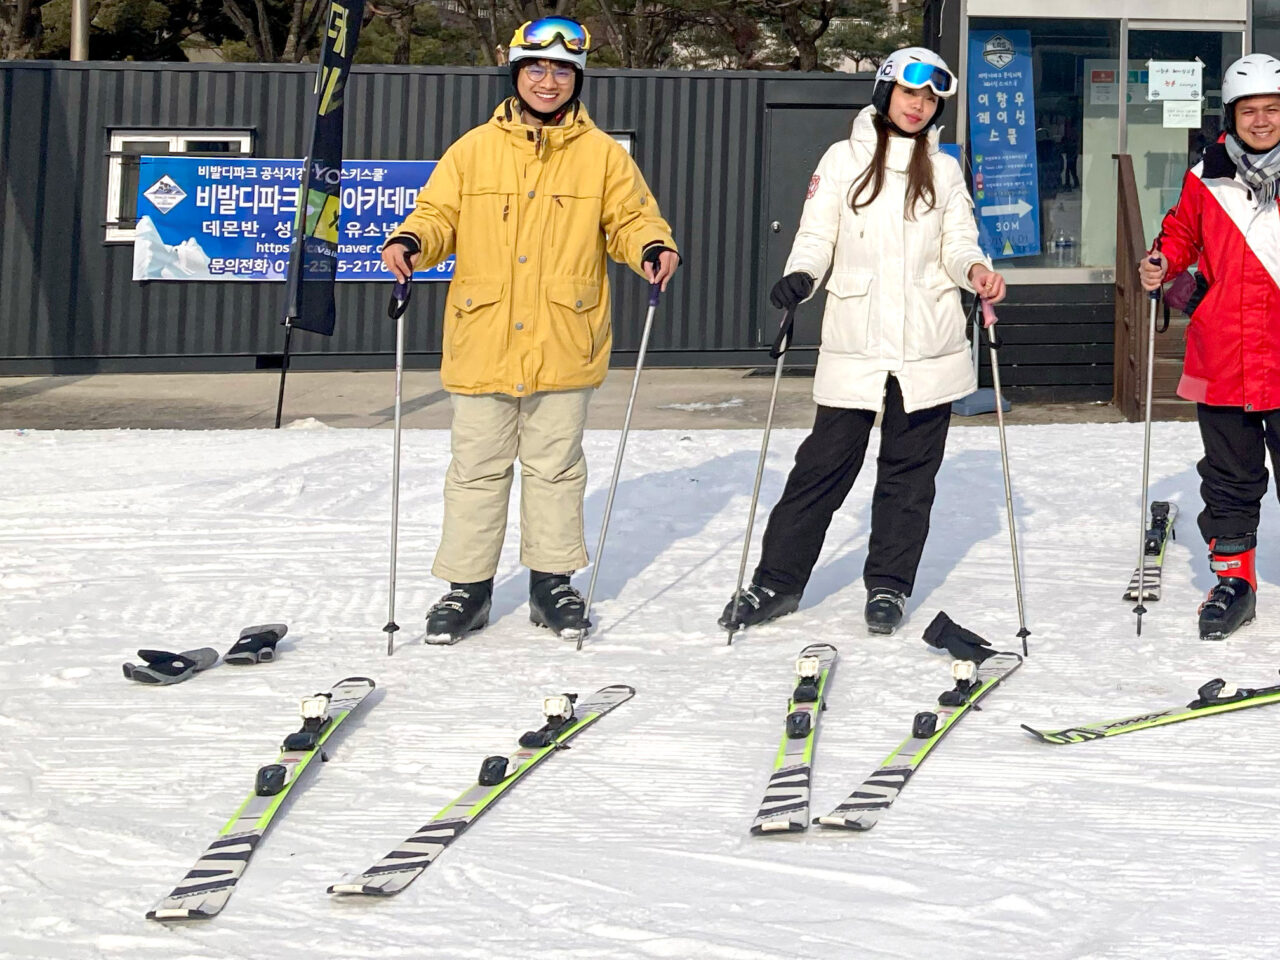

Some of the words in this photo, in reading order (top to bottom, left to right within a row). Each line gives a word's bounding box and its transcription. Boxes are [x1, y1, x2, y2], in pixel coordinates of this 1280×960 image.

[198, 166, 257, 180] 비발디파크
[196, 185, 299, 215] 비발디파크
[274, 221, 292, 237] 성
[210, 258, 269, 274] 문의전화
